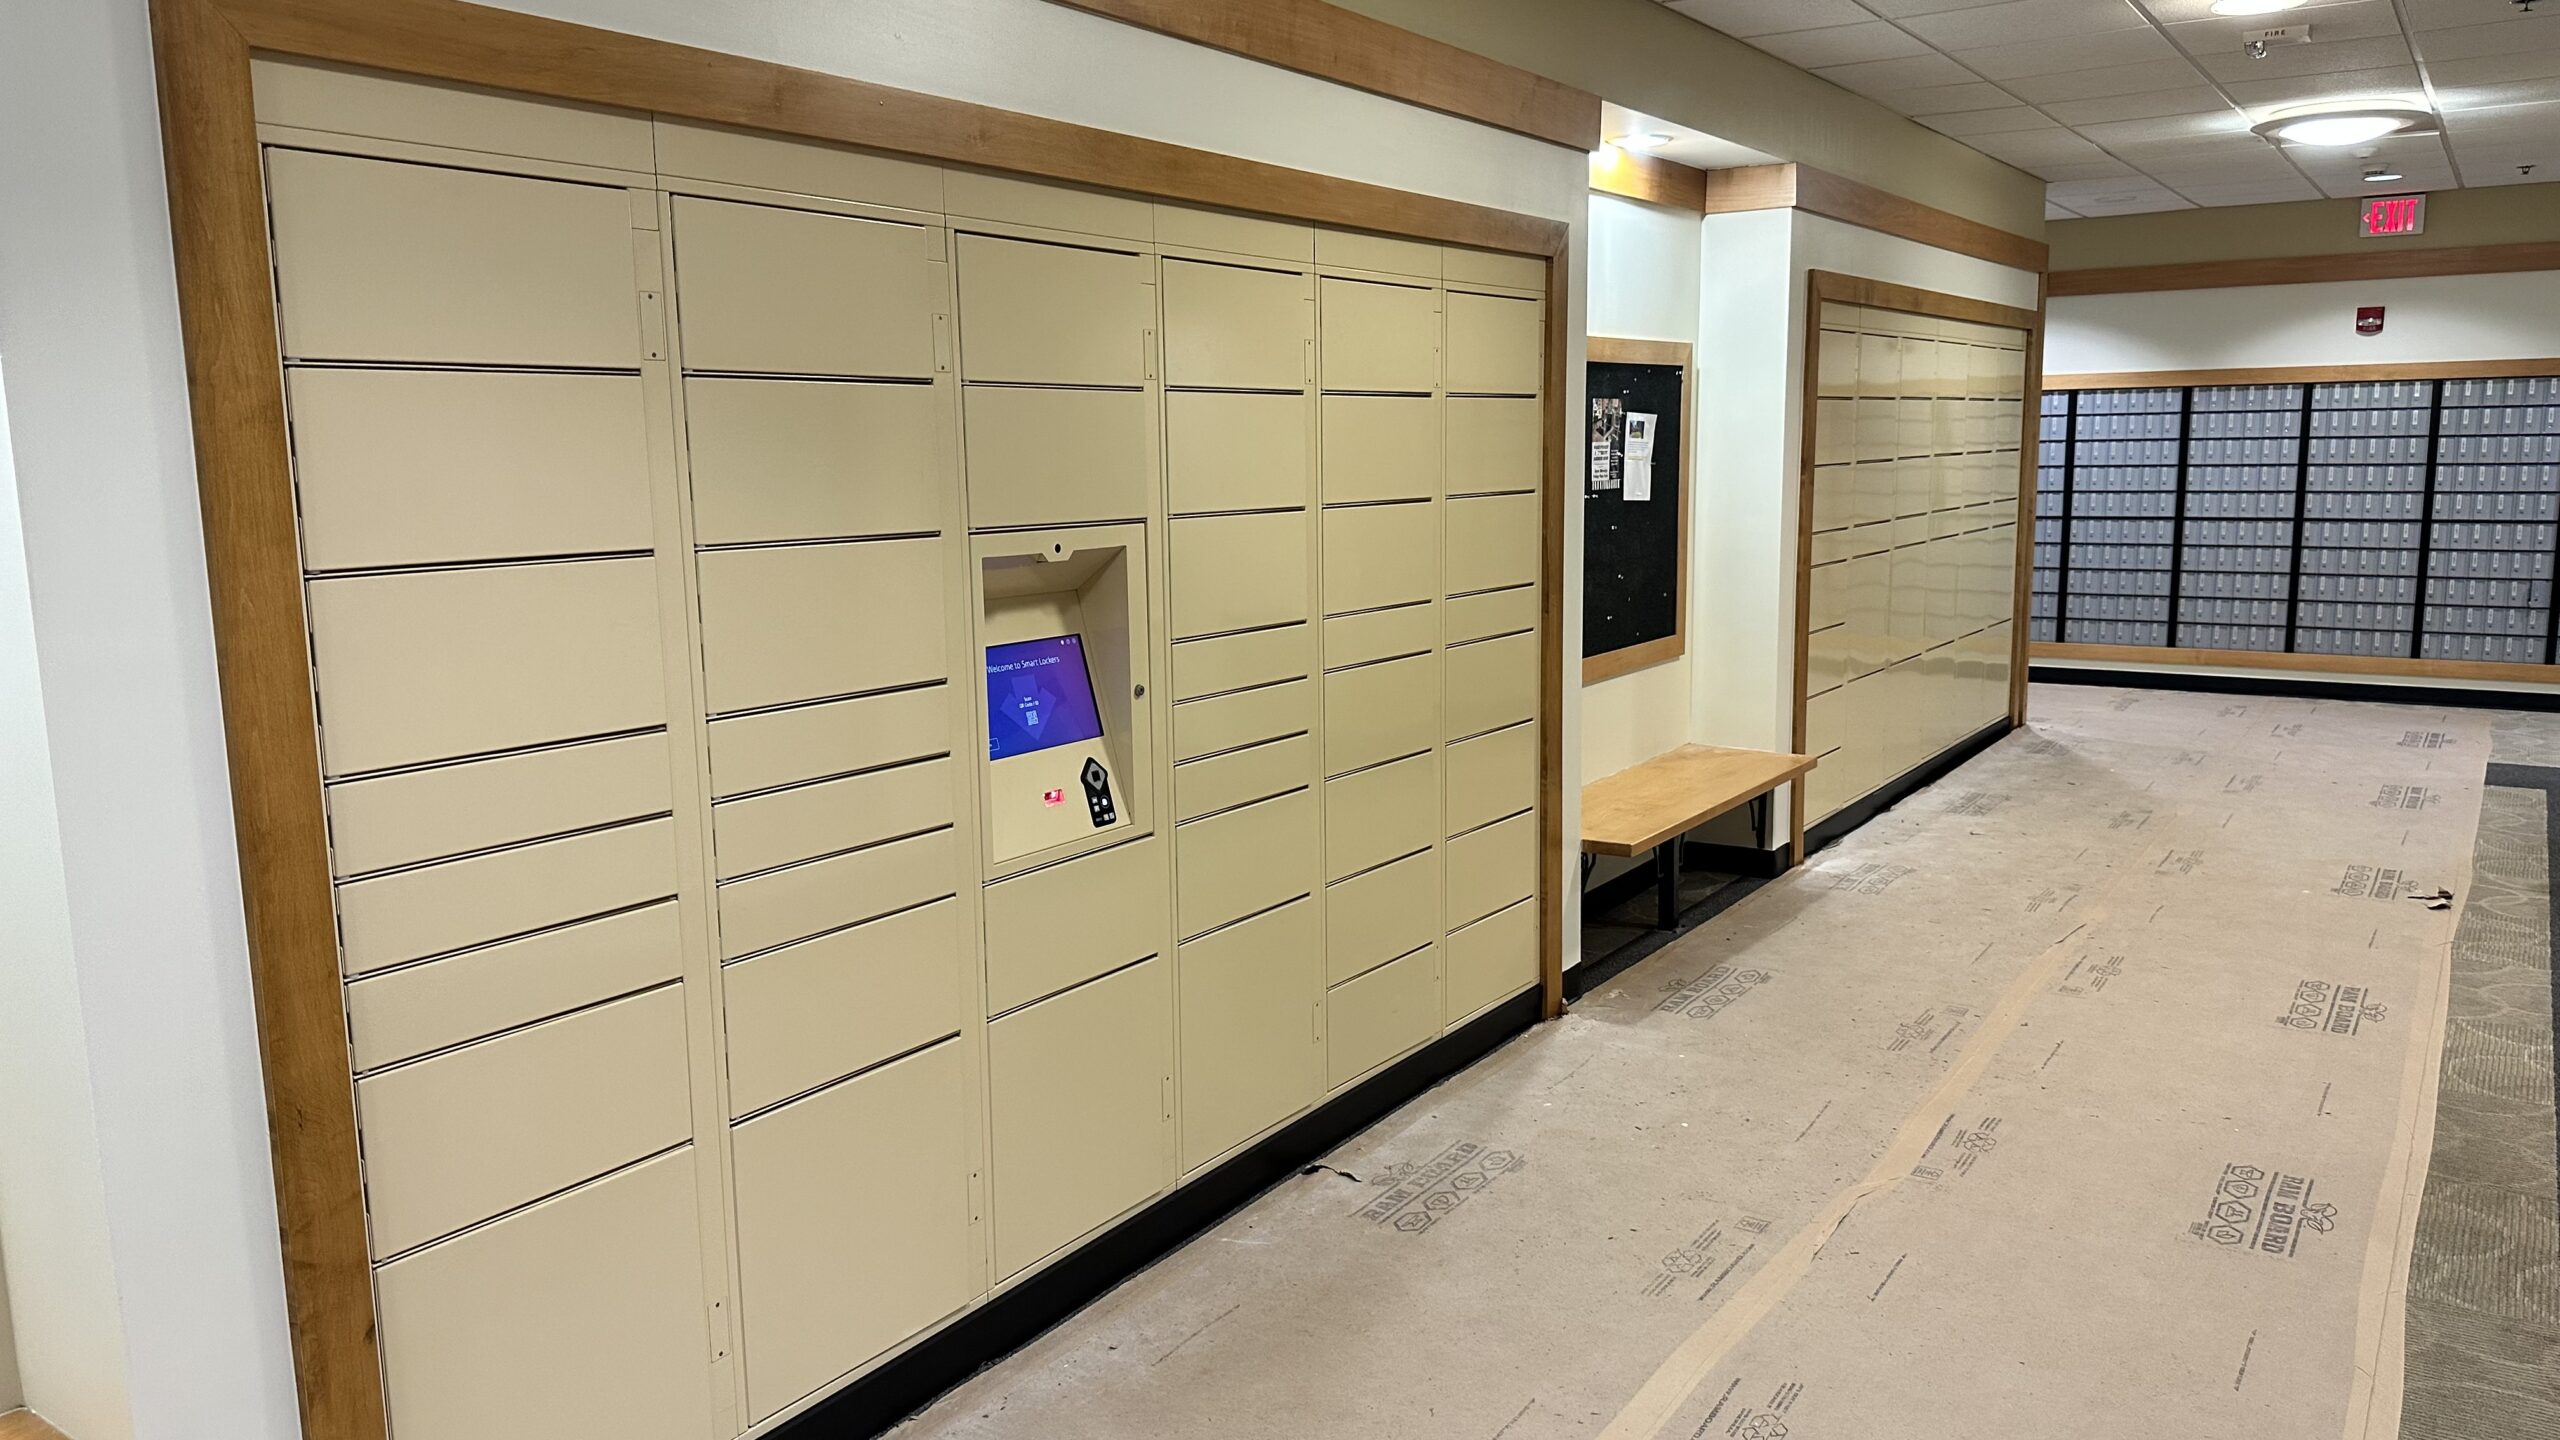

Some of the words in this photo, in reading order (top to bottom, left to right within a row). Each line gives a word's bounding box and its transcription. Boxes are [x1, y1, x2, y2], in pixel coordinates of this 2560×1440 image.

[2264, 29, 2286, 37] FIRE
[2369, 198, 2418, 234] EXIT
[986, 662, 1014, 674] Welcome
[1014, 662, 1021, 670] to
[1021, 659, 1039, 668] Smart
[1039, 656, 1060, 666] Lockers
[2277, 1174, 2304, 1201] RAM
[2261, 1201, 2296, 1254] BOARD
